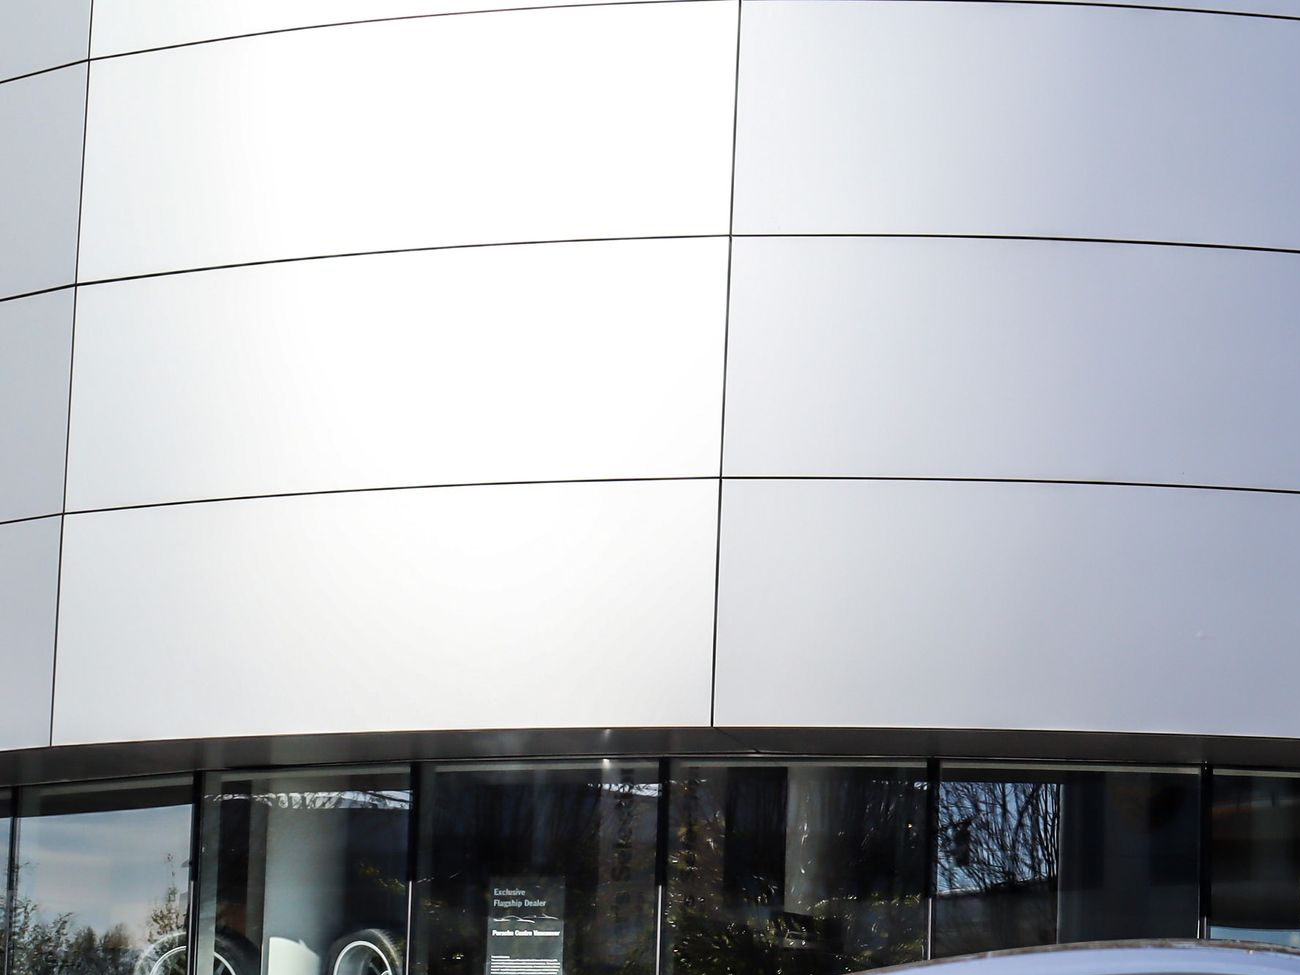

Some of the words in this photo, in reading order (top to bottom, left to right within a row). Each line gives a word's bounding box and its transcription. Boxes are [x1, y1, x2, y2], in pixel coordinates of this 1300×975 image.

[493, 888, 526, 896] Exclusive
[493, 899, 523, 908] Flagship
[524, 899, 547, 907] Dealer
